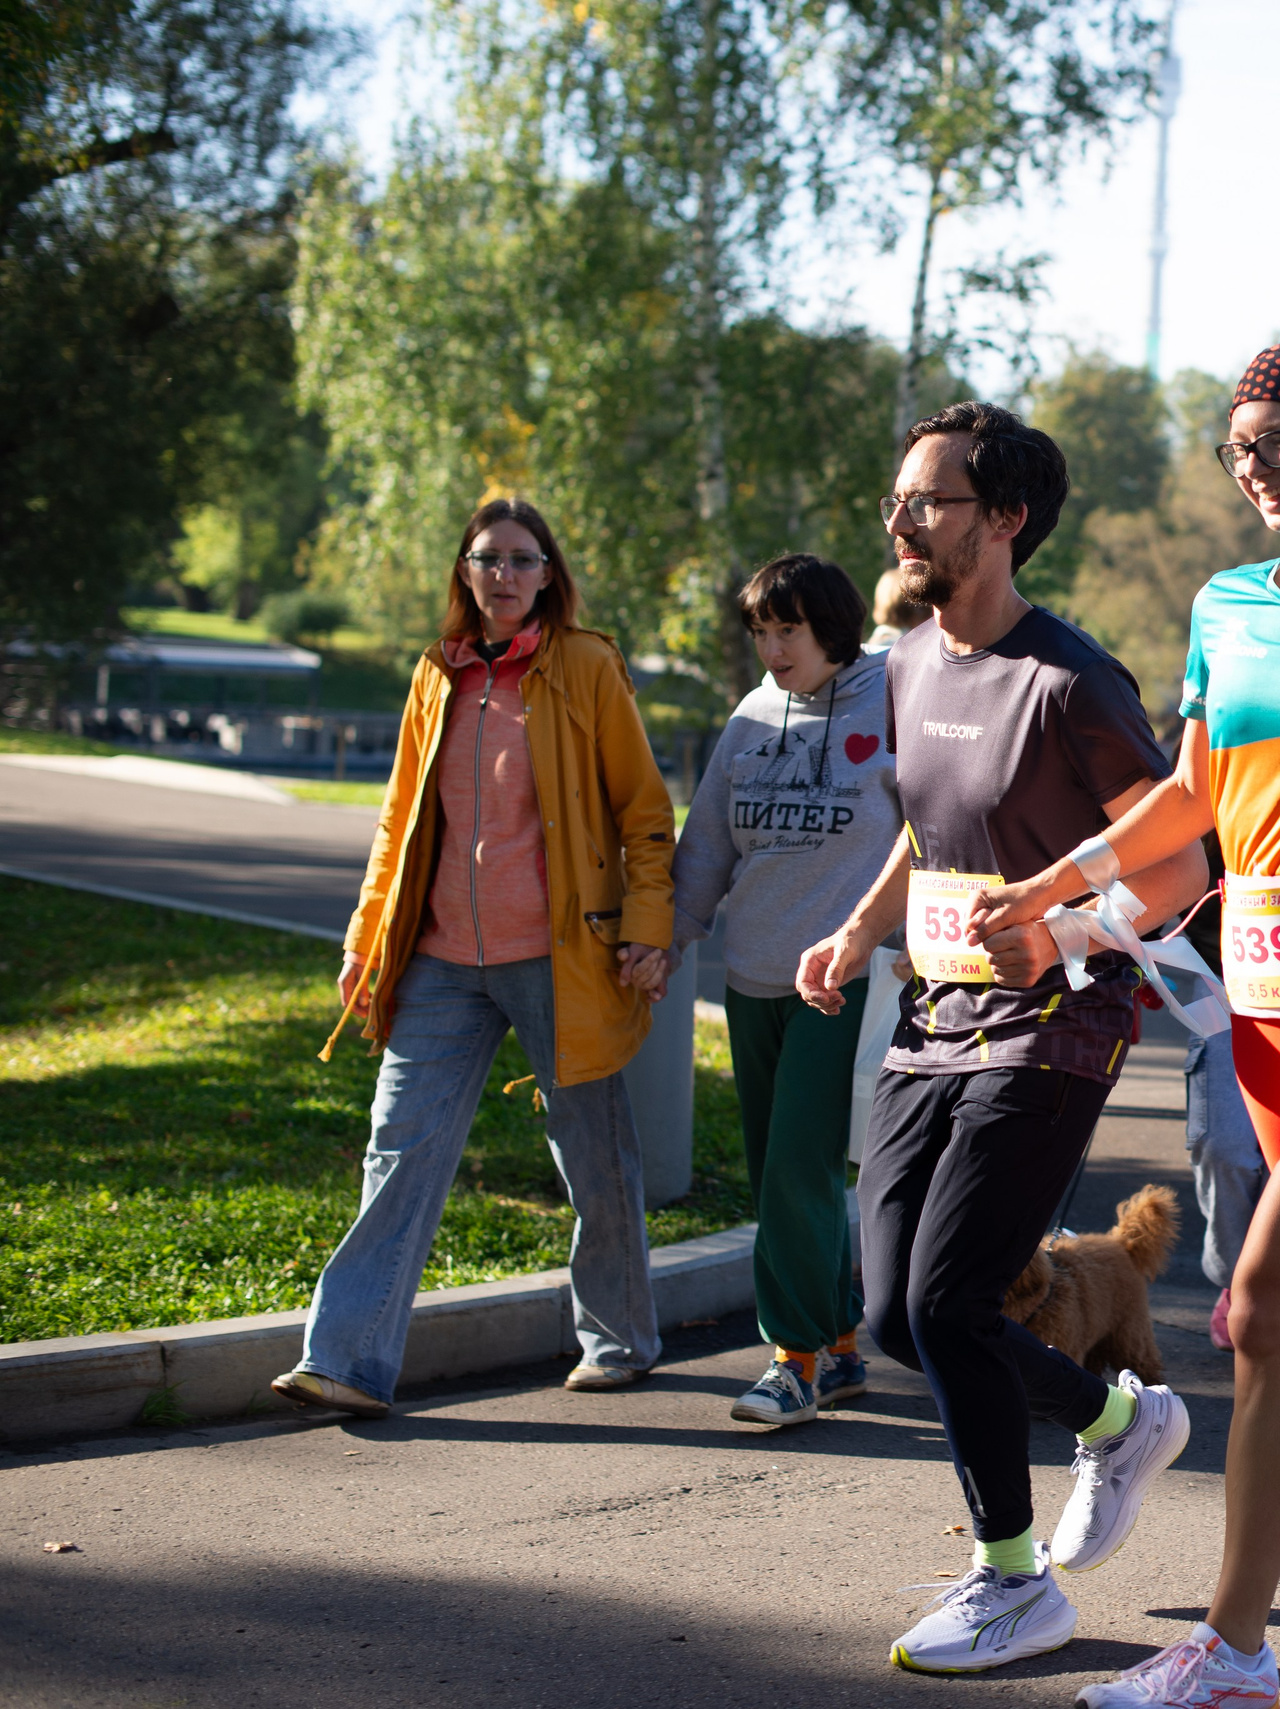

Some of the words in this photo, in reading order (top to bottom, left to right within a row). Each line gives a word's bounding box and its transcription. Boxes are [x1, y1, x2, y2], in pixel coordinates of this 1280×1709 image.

[923, 721, 983, 740] TRAILCONF
[734, 801, 854, 835] ПИТЕР
[749, 838, 772, 852] Saint
[773, 834, 826, 850] Petersburg
[925, 906, 968, 942] 53
[938, 959, 958, 977] 5,5
[1248, 983, 1268, 1000] 5,5
